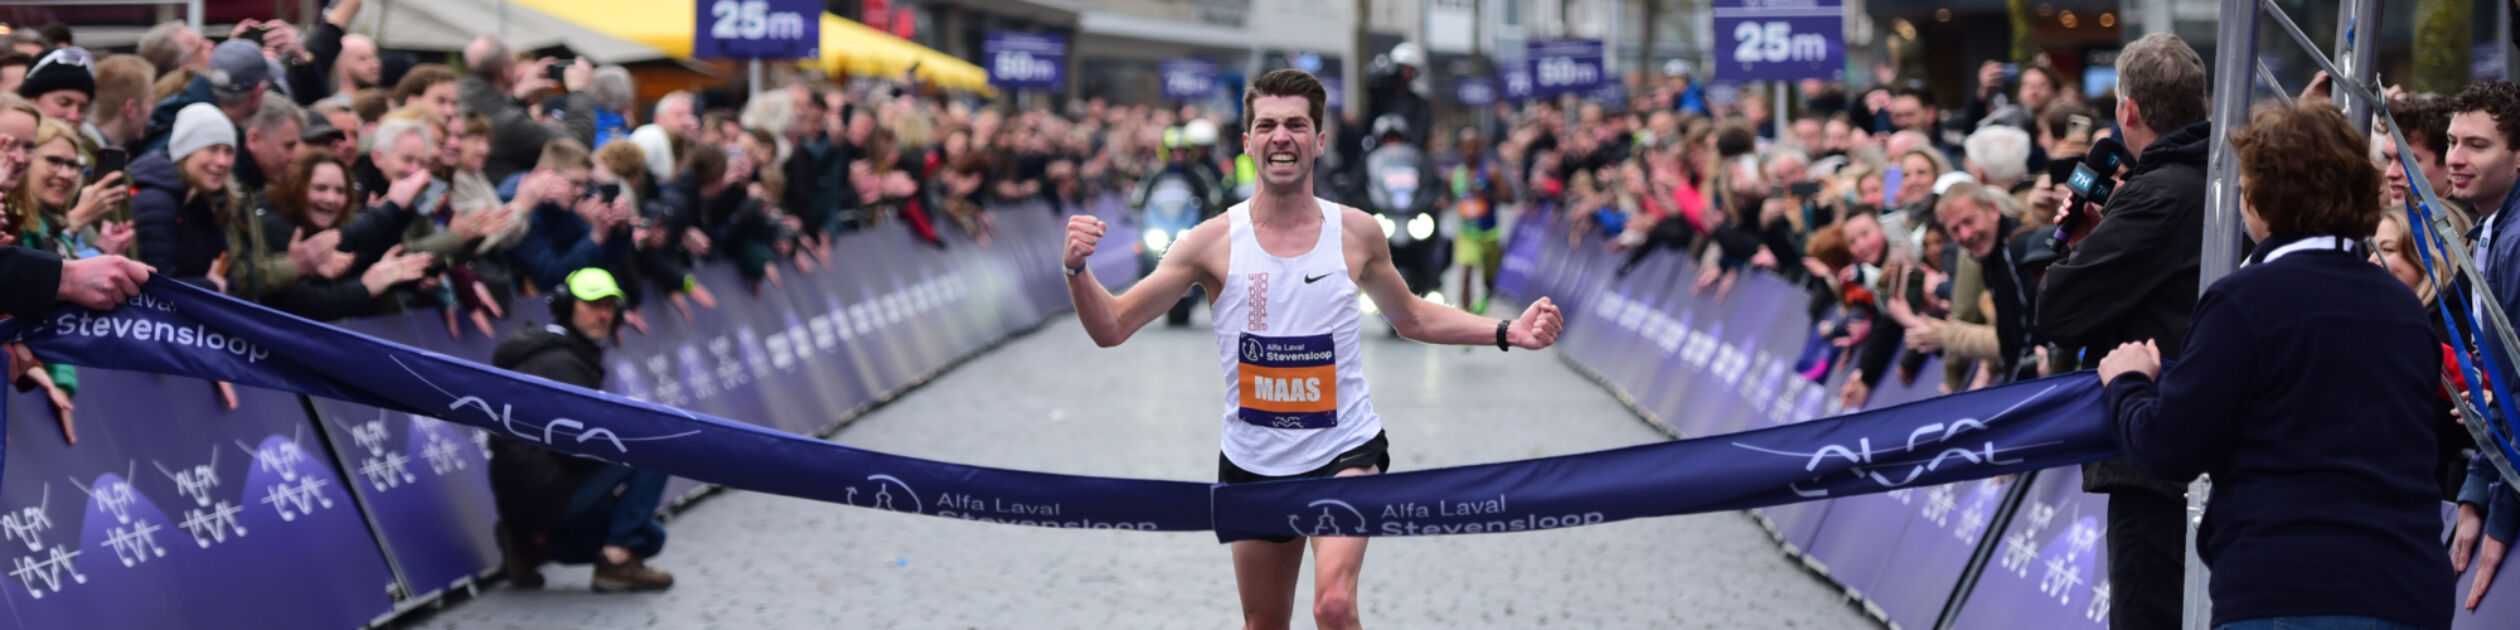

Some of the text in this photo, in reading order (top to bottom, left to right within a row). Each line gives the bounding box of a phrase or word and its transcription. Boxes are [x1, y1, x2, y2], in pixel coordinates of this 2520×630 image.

[711, 0, 804, 40] 25m
[1734, 21, 1827, 62] 25m
[2074, 171, 2091, 188] 7H
[128, 292, 178, 313] ava
[55, 313, 270, 363] Stevensloop
[1266, 343, 1305, 351] Alfa Laval
[1266, 350, 1332, 361] Stevensloop
[1254, 375, 1321, 403] MAAS
[1790, 441, 2024, 497] LVAL
[936, 492, 1060, 516] Alfa Laval
[1381, 494, 1506, 519] Alfa Laval
[1381, 511, 1605, 537] Stevensloop
